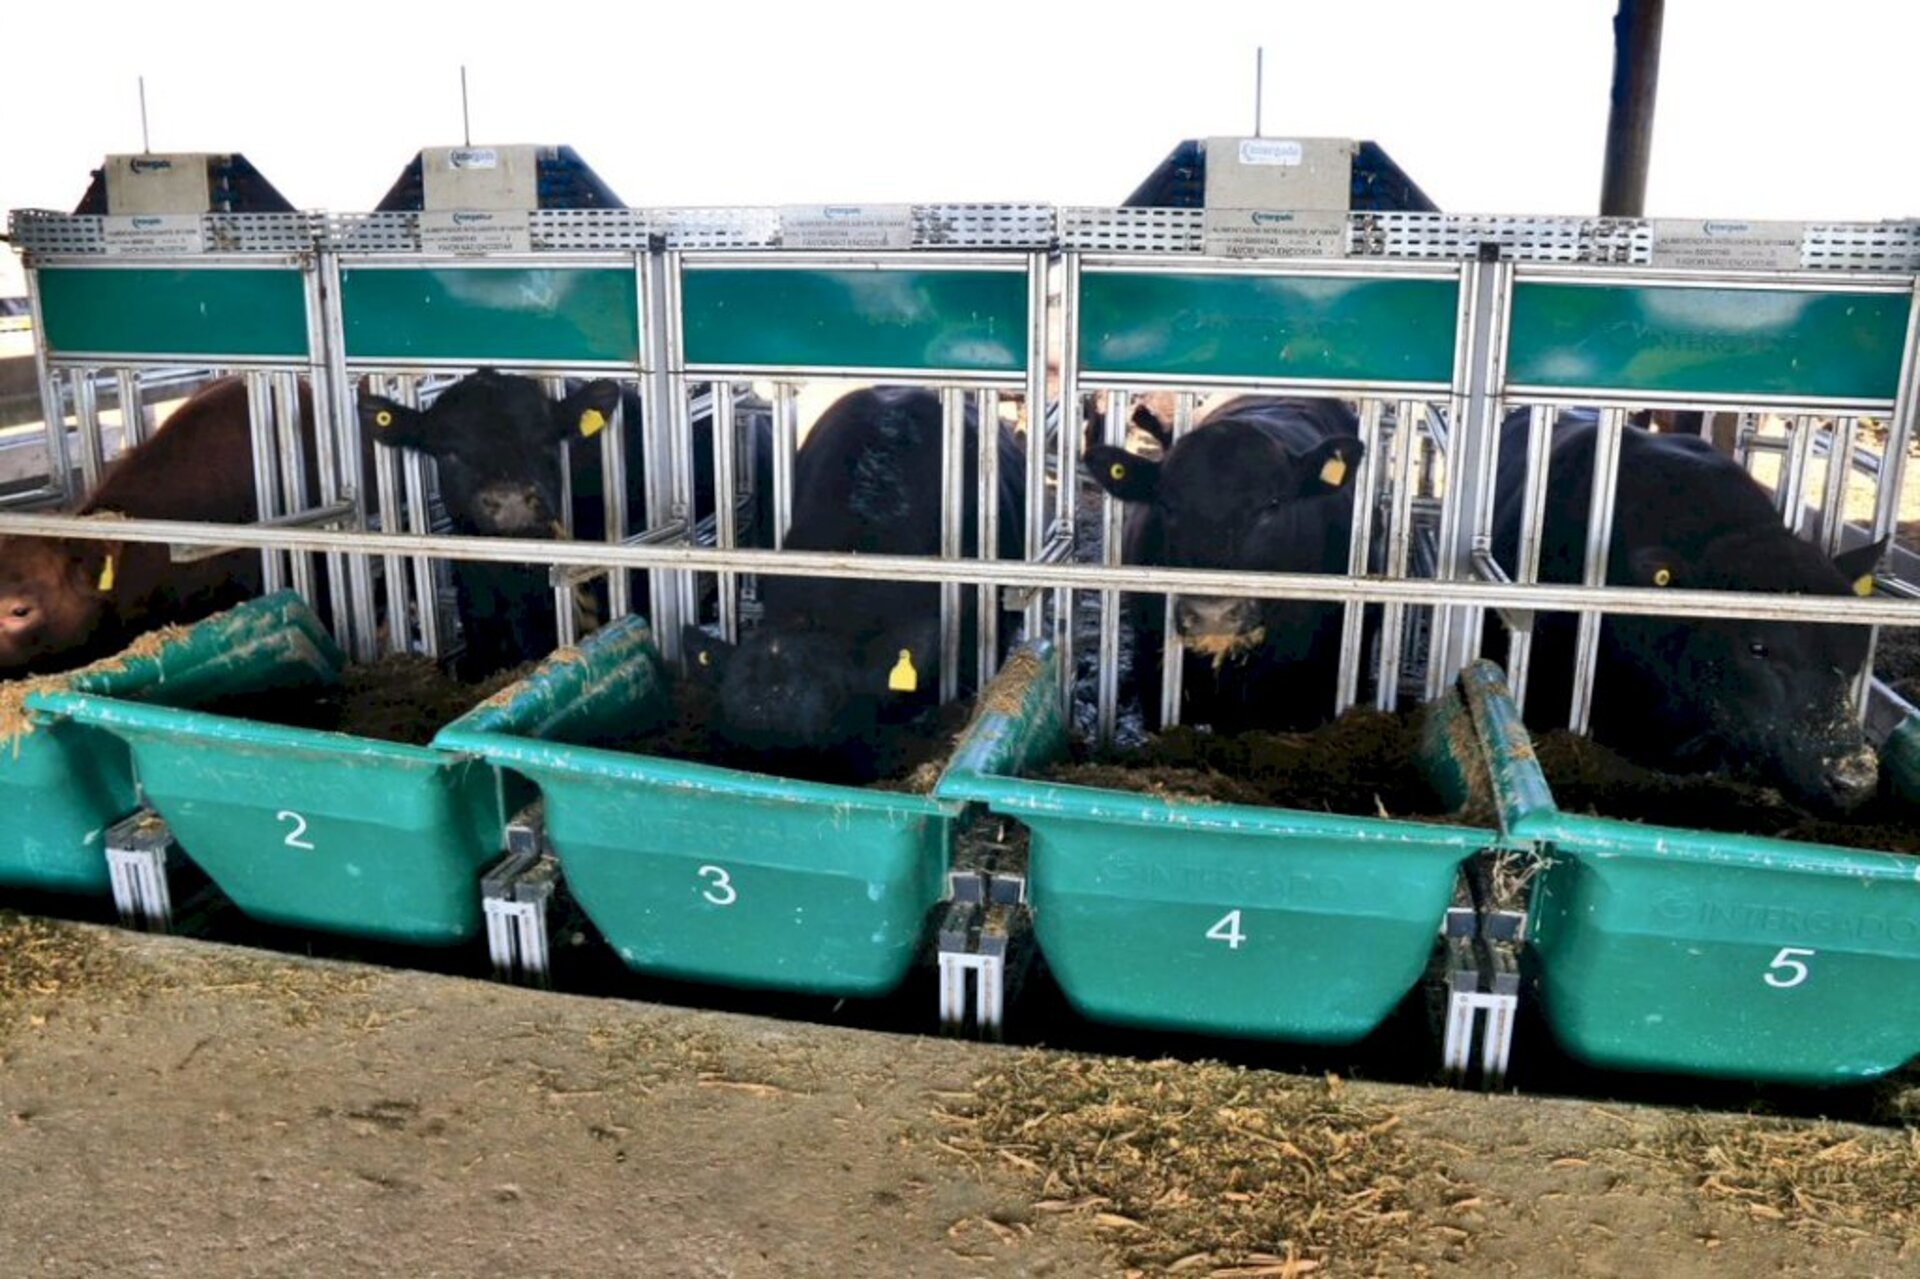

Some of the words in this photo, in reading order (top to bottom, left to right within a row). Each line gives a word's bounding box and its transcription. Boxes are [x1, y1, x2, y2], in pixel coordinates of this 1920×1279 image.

[276, 810, 315, 850] 2
[697, 864, 737, 906] 3
[1204, 908, 1247, 950] 4
[1762, 947, 1816, 988] 5
